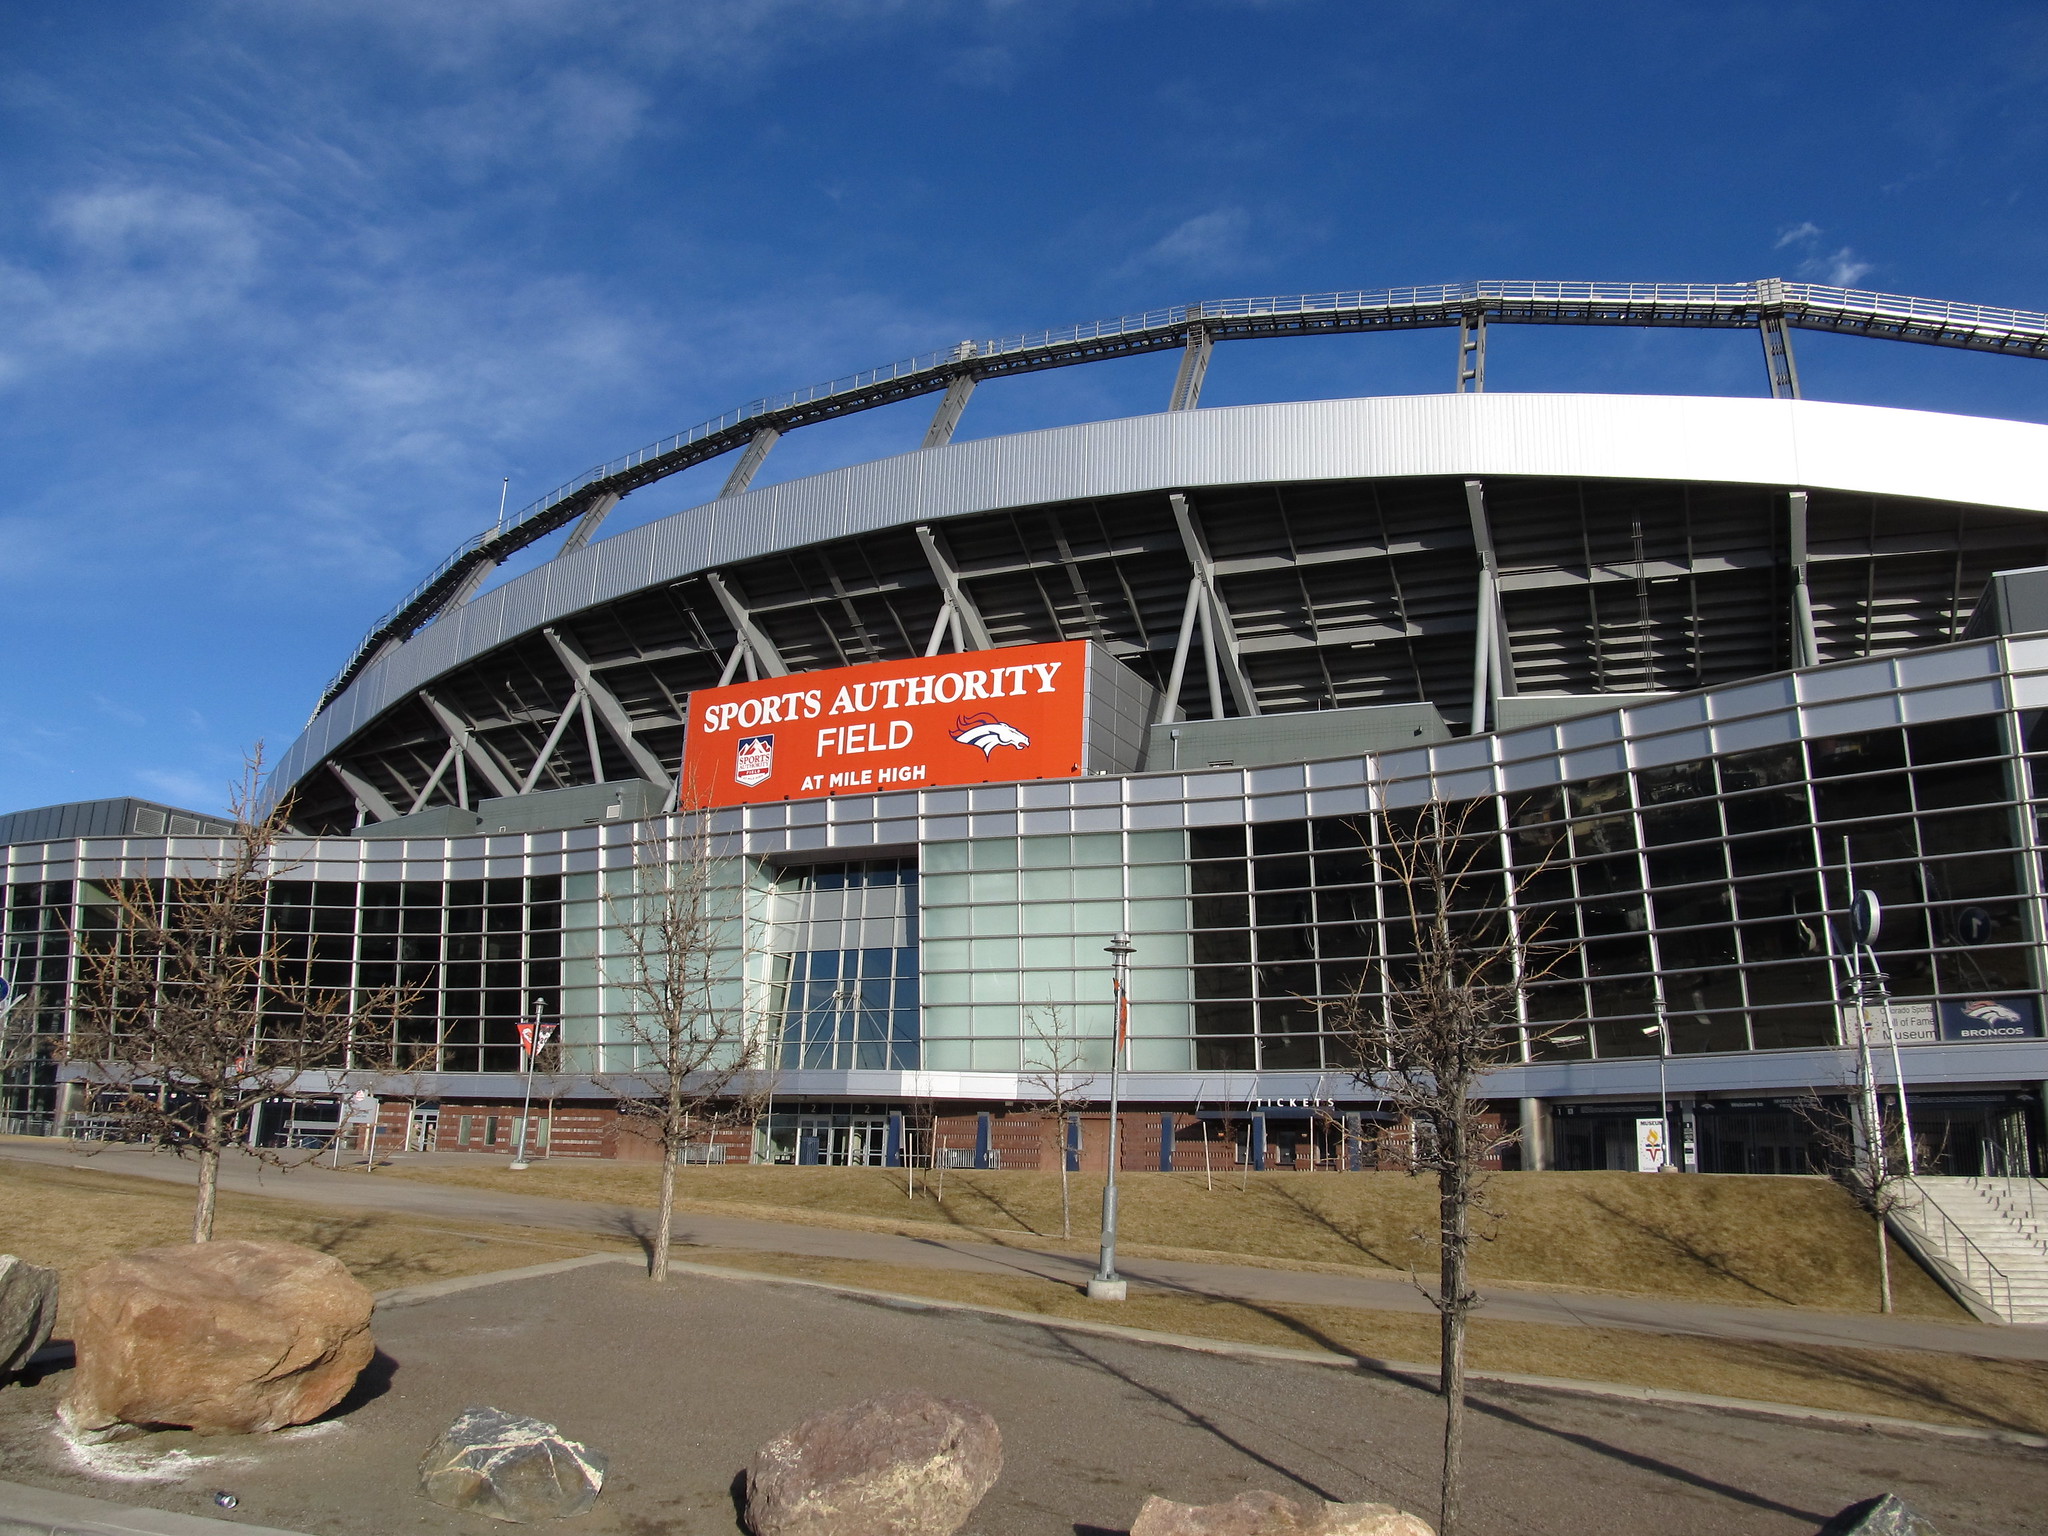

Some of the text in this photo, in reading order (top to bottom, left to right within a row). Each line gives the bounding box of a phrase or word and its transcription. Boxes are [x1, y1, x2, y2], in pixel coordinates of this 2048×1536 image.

[704, 662, 1061, 732] SPORTS AUTHORITY
[817, 721, 913, 757] FIELD
[739, 753, 770, 765] SPORTS
[801, 765, 926, 791] AT MILE HIGH
[1882, 1017, 1935, 1026] Hll of Fame
[1961, 1027, 2024, 1037] BRONCOS
[1256, 1098, 1334, 1107] TICKETS
[811, 1104, 816, 1112] 2
[865, 1105, 870, 1113] 2
